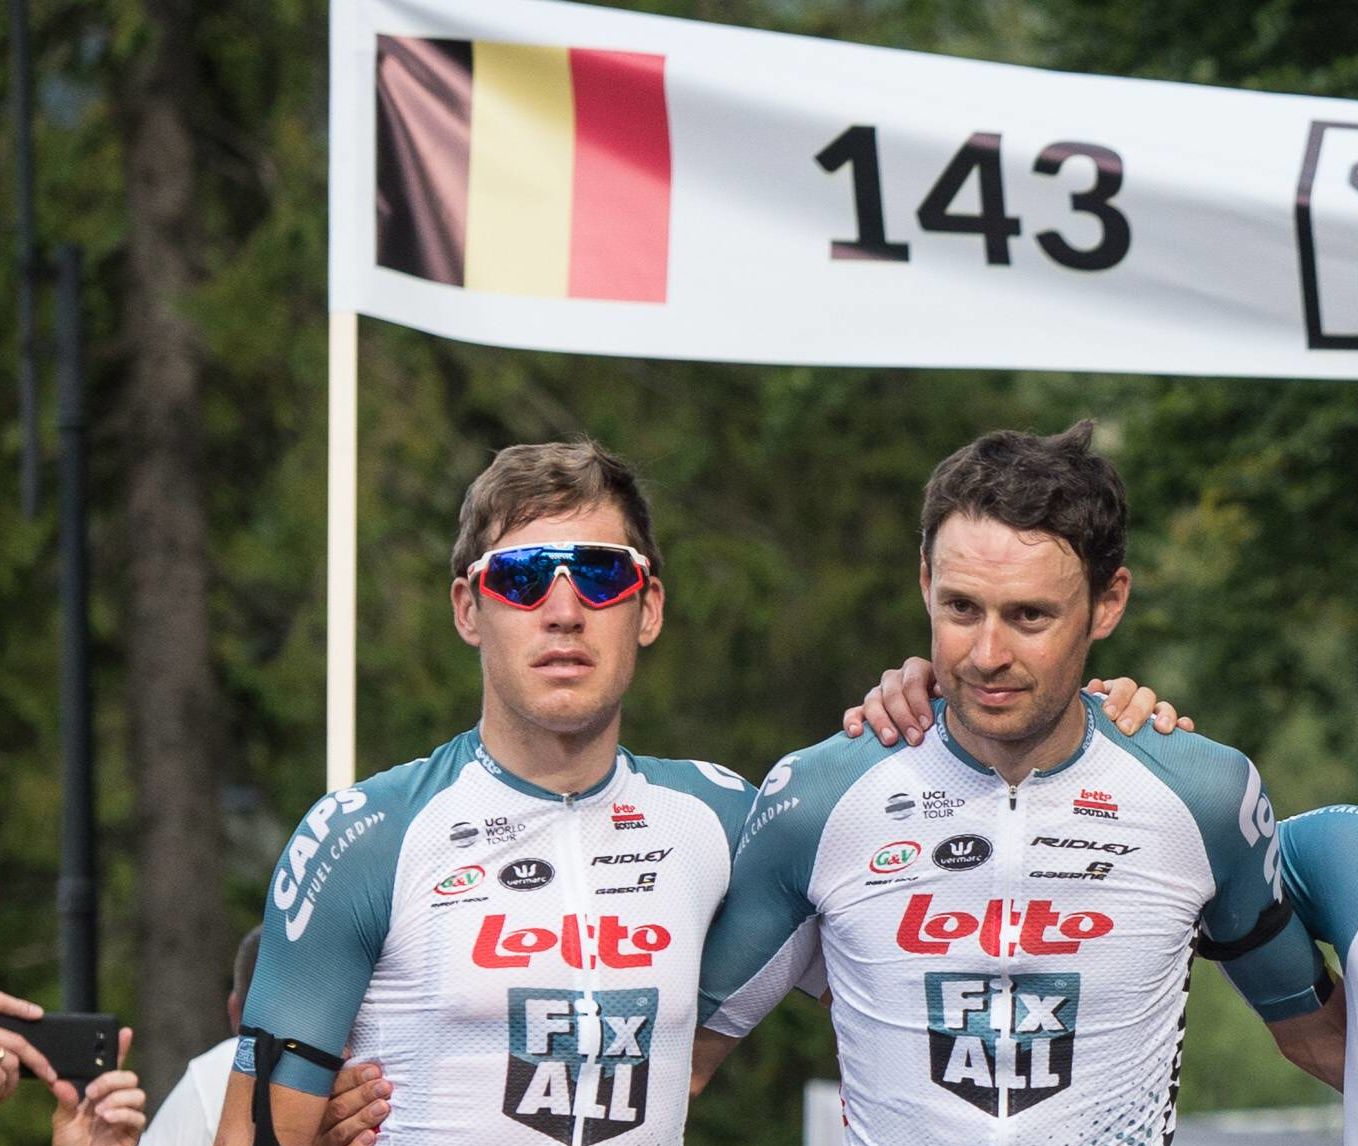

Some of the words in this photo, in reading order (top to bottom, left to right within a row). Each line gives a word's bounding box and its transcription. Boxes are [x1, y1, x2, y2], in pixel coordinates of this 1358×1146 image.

[812, 124, 1133, 272] 143
[922, 790, 946, 800] UCI
[922, 797, 966, 810] WORLD
[484, 817, 508, 827] UCI
[751, 806, 775, 836] CARD
[922, 808, 954, 819] TOUR
[1073, 807, 1119, 820] SOUDAL
[485, 823, 526, 837] WORLD
[273, 787, 368, 911] CAPS
[1030, 836, 1141, 856] RIDLEY
[307, 861, 333, 903] FUEL
[330, 820, 366, 860] CARD
[590, 847, 674, 866] RIDLEY
[875, 849, 916, 866] G&V
[940, 853, 983, 865] vermarc
[943, 1037, 1060, 1090] ALL
[515, 1060, 637, 1123] ALL
